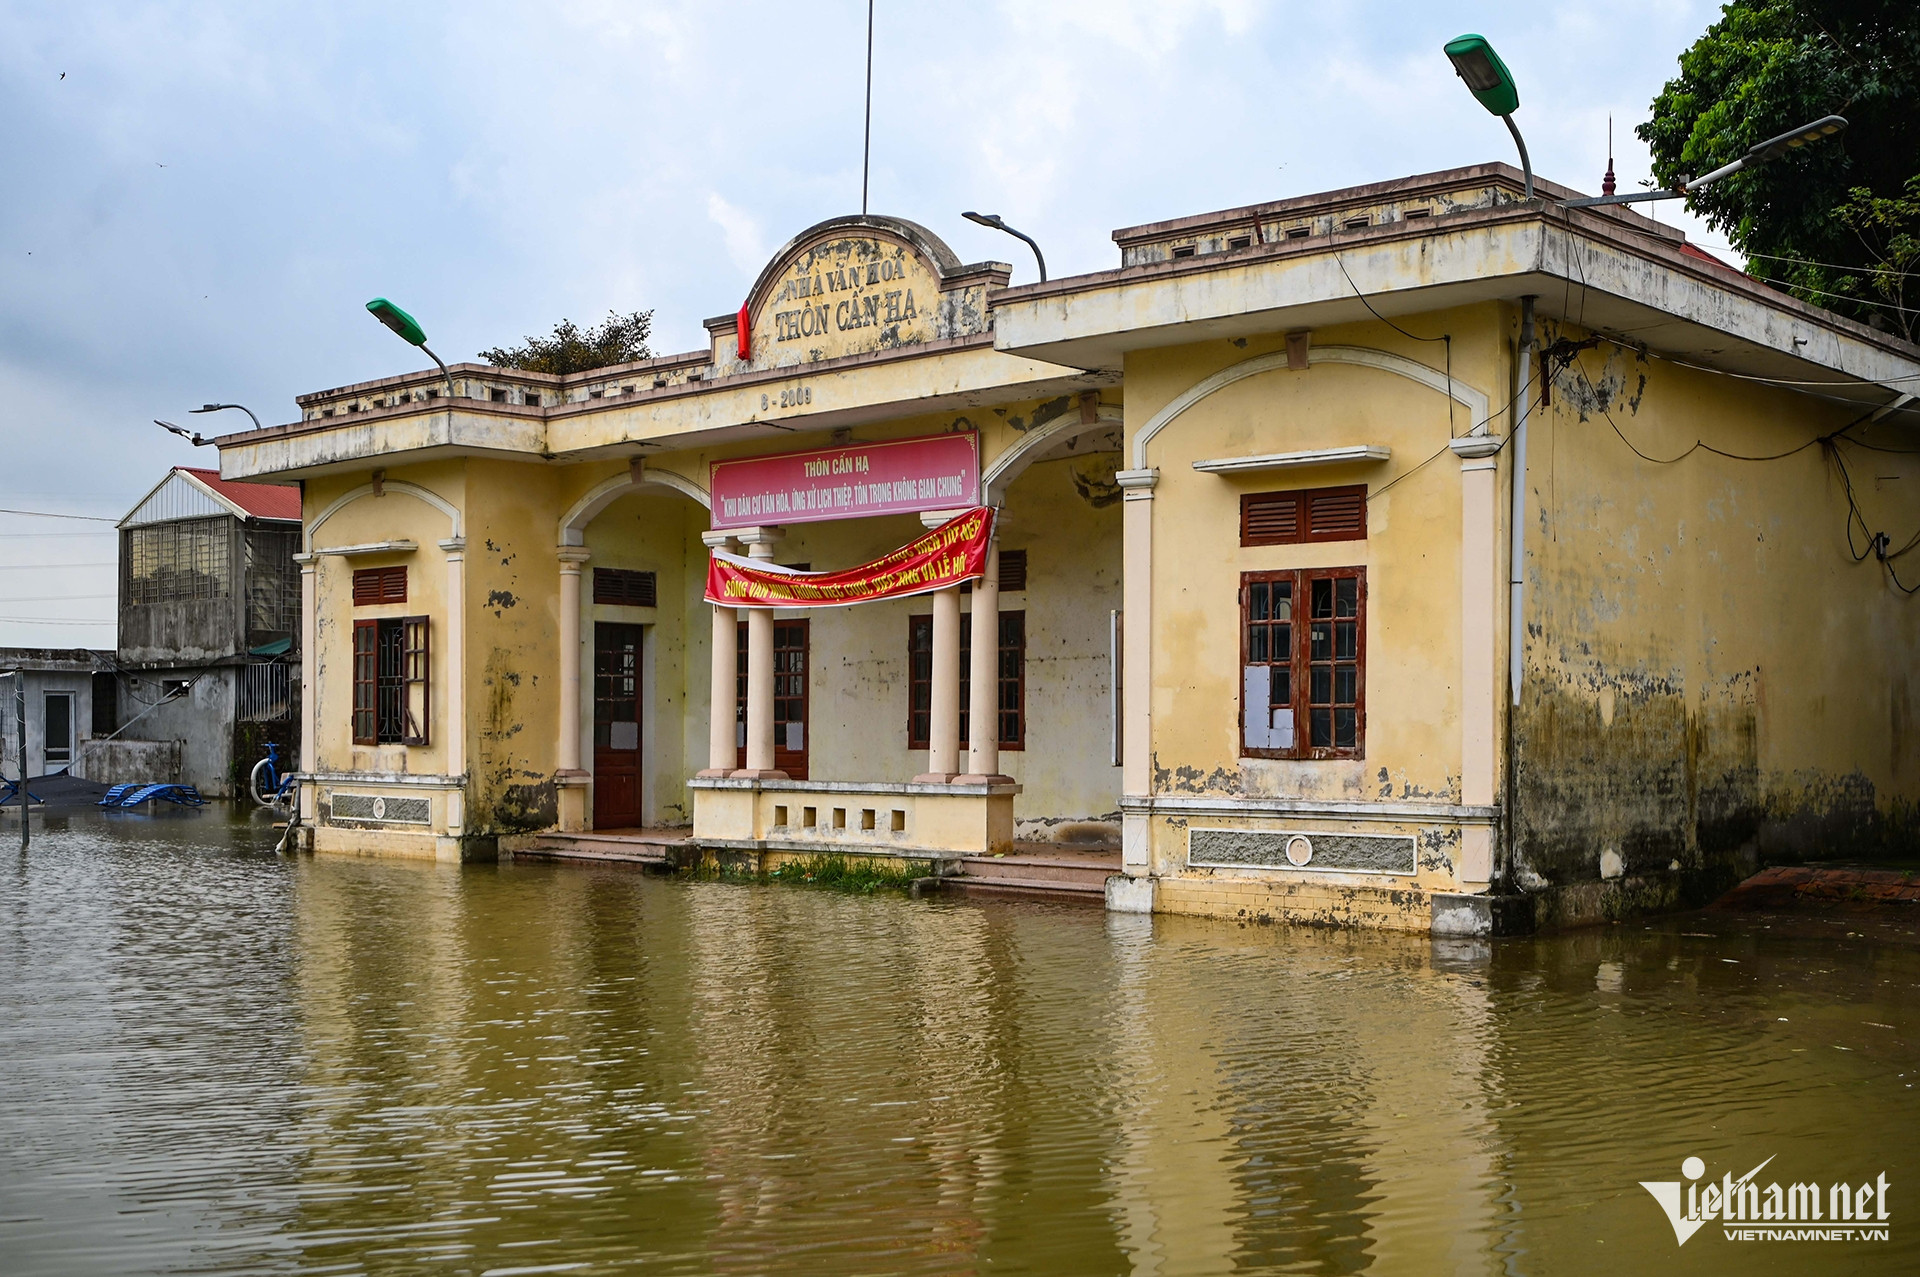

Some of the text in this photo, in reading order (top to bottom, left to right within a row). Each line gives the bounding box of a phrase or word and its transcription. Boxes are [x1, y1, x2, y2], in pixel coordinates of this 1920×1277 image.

[786, 267, 824, 301] NHÀ
[826, 262, 864, 292] VĂN
[776, 286, 917, 342] THÔN CẤN HẠ
[781, 387, 811, 408] 2009
[804, 452, 869, 478] THÔN CẤN HẠ
[738, 493, 751, 516] DÂN
[752, 494, 762, 515] CƯ
[762, 491, 774, 514] VĂN
[776, 489, 791, 514] HÓA,
[792, 488, 805, 511] ỨNG
[807, 483, 817, 510] XỬ
[818, 488, 832, 513] LỊCH
[833, 482, 854, 511] THIỆP,
[854, 481, 868, 505] TÔN
[869, 482, 892, 508] TRỌNG
[893, 476, 917, 501] KHÔNG
[918, 478, 936, 499] GIAN
[960, 515, 981, 541] NẾP
[724, 574, 748, 598] SỐNG
[937, 552, 951, 579] LỄ
[953, 551, 967, 577] HỘI
